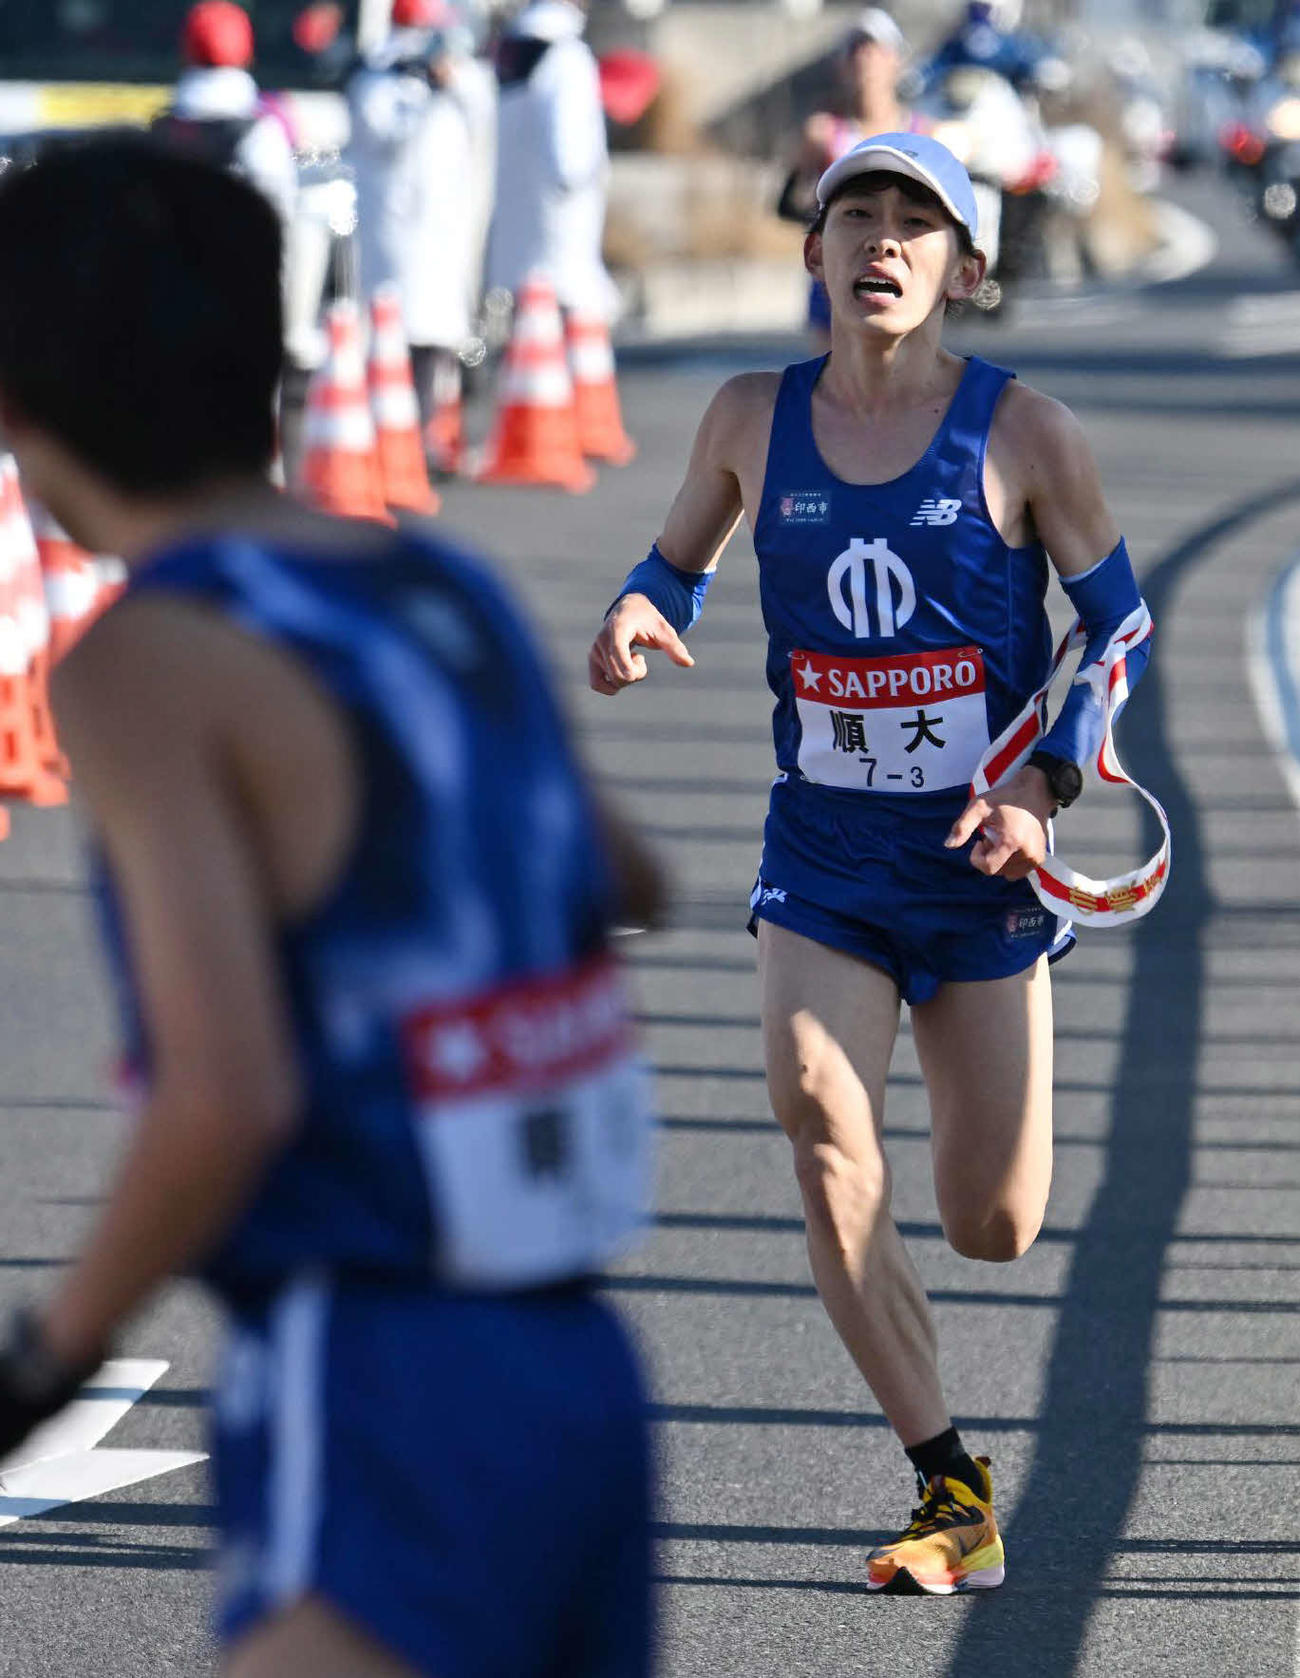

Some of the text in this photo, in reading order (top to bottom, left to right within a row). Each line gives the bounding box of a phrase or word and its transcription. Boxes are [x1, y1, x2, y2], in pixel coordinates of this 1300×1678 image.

[795, 501, 829, 515] 印西市
[827, 660, 976, 699] SAPPORO
[859, 757, 925, 788] 7-3
